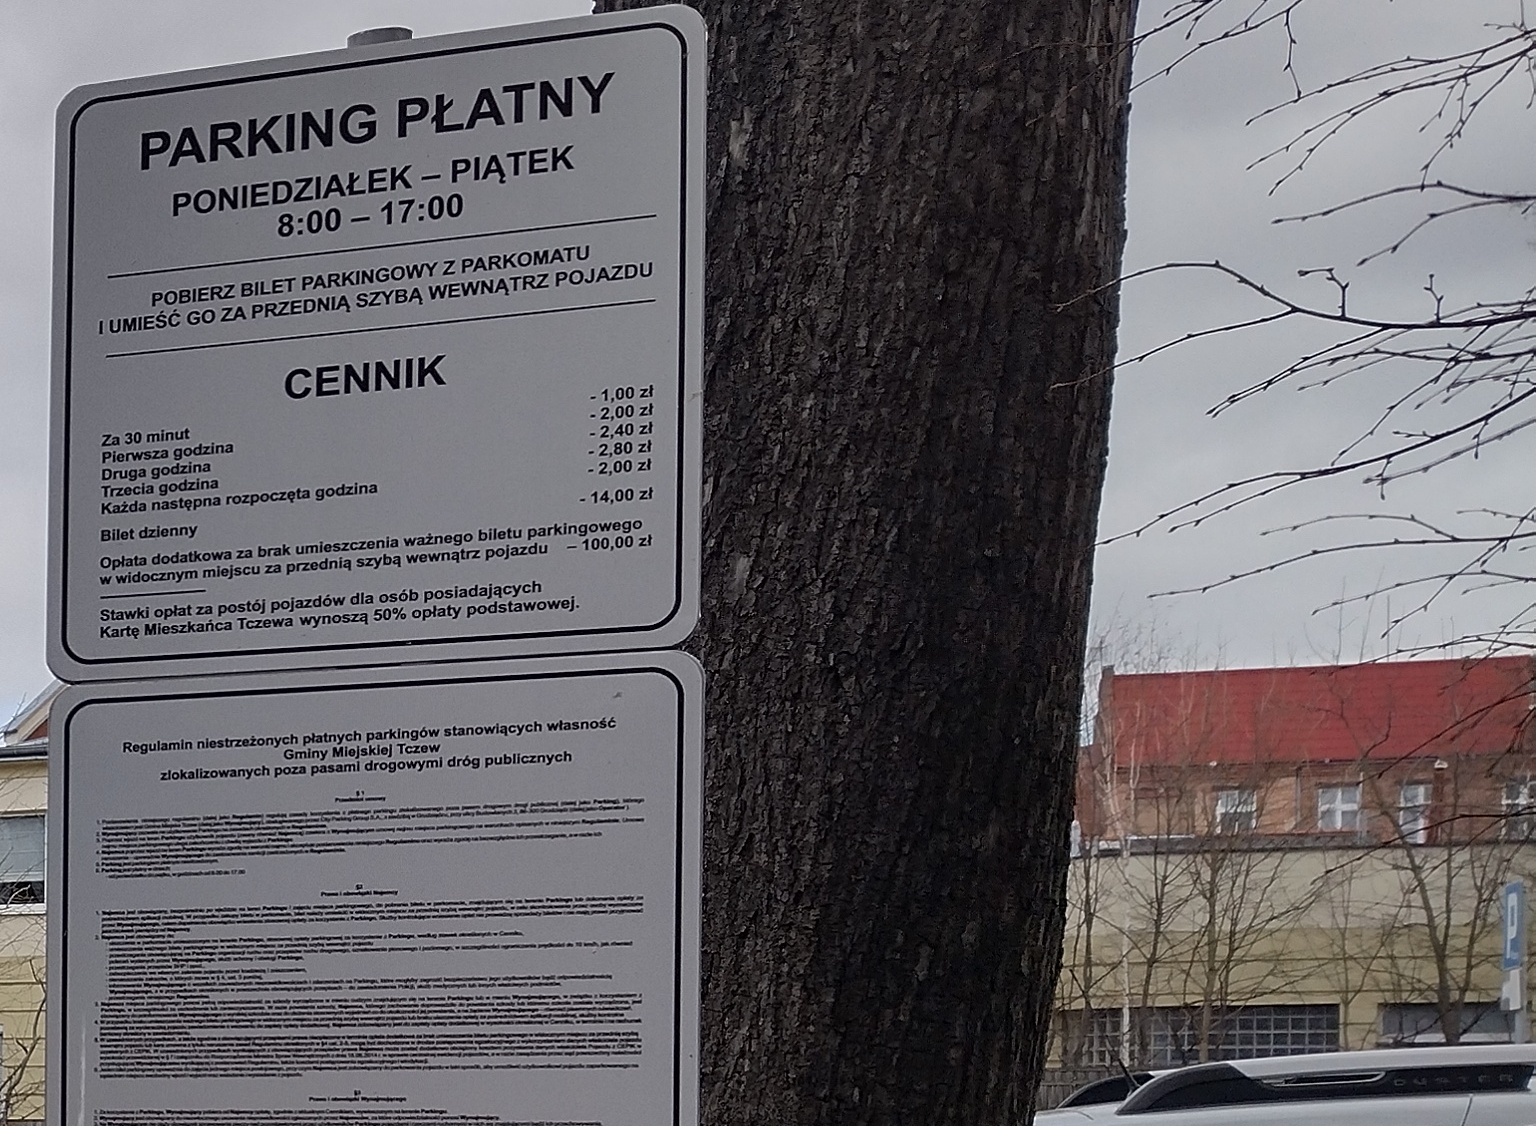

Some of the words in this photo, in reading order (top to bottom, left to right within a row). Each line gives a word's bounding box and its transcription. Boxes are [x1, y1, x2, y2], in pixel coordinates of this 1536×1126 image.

[140, 103, 377, 171] PARKING
[397, 71, 616, 139] PŁATNY
[172, 164, 413, 217] PONIEDZIAŁEK
[451, 144, 575, 185] PIĄTEK
[277, 207, 342, 238] 8:00
[380, 193, 464, 226] 17:00
[151, 283, 236, 308] POBIERZ
[240, 277, 297, 298] BILET
[301, 261, 439, 292] PARKINGOWY
[442, 259, 456, 276] Z
[461, 244, 590, 274] PARKOMATU
[98, 320, 104, 335] I
[109, 308, 182, 334] UMIEŚĆ
[186, 308, 216, 326] GO
[220, 305, 247, 323] ZA
[251, 294, 351, 320] PRZEDNIĄ
[355, 287, 424, 309] SZYBĄ
[428, 272, 550, 301] WEWNĄTRZ
[555, 261, 653, 288] POJAZDU
[284, 354, 447, 400] CENNIK
[600, 386, 635, 404] 1,00
[639, 384, 654, 399] zł
[600, 404, 635, 422] 2,00
[638, 402, 654, 417] zł
[101, 433, 121, 448] Za
[124, 431, 142, 445] 30
[146, 427, 190, 443] minut
[599, 422, 634, 440] 2,40
[638, 420, 654, 436] zł
[101, 449, 169, 464] Pierwsza
[173, 441, 234, 461] godzina
[598, 441, 633, 459] 2,80
[637, 439, 653, 454] zł
[101, 468, 147, 482] Druga
[150, 461, 211, 480] godzina
[598, 459, 633, 477] 2,00
[637, 457, 652, 472] zł
[100, 482, 155, 498] Trzecia
[158, 476, 219, 497] godzina
[101, 499, 147, 515] Każda
[151, 496, 222, 512] następna
[225, 487, 311, 507] rozpoczęta
[315, 481, 378, 502] godzina
[590, 488, 634, 506] 14,00
[638, 486, 654, 501] zł
[99, 554, 148, 572] Opłata
[151, 550, 233, 566] dodatkowa
[235, 549, 254, 560] za
[257, 543, 292, 558] brak
[295, 535, 399, 556] umieszczenia
[403, 532, 474, 547] ważnego
[477, 527, 523, 542] biletu
[527, 519, 643, 541] parkingowego
[100, 528, 135, 542] Bilet
[138, 525, 198, 539] dzienny
[99, 575, 113, 586] w
[115, 569, 199, 585] widocznym
[202, 564, 261, 580] miejscu
[264, 563, 282, 575] za
[286, 556, 352, 576] przednią
[356, 553, 402, 570] szybą
[405, 548, 481, 565] wewnątrz
[485, 542, 548, 562] pojazdu
[581, 535, 634, 552] 100,00
[638, 533, 653, 547] zł
[99, 606, 150, 622] Stawki
[153, 604, 193, 621] opłat
[195, 605, 214, 616] za
[217, 598, 266, 618] postój
[270, 593, 346, 614] pojazdów
[349, 591, 374, 606] dla
[378, 588, 419, 604] osób
[423, 580, 542, 604] posiadających
[99, 625, 140, 640] Kartę
[144, 618, 233, 636] Mieszkańca
[236, 617, 294, 630] Tczewa
[298, 612, 369, 629] wynoszą
[373, 606, 407, 622] 50%
[411, 604, 462, 622] opłaty
[466, 595, 580, 619] podstawowej.
[122, 738, 193, 755] Regulamin
[196, 733, 299, 750] niestrzeżonych
[302, 730, 362, 747] płatnych
[366, 726, 441, 744] parkingów
[443, 720, 543, 737] stanowiących
[546, 716, 617, 732] własność
[160, 764, 271, 781] zlokalizowanych
[274, 765, 307, 779] poza
[310, 760, 360, 777] pasami
[364, 756, 443, 774] drogowymi
[447, 754, 481, 770] dróg
[484, 750, 572, 769] publicznych
[283, 747, 329, 762] Gminy
[332, 743, 393, 760] Miejskiej
[396, 742, 441, 755] Tczew
